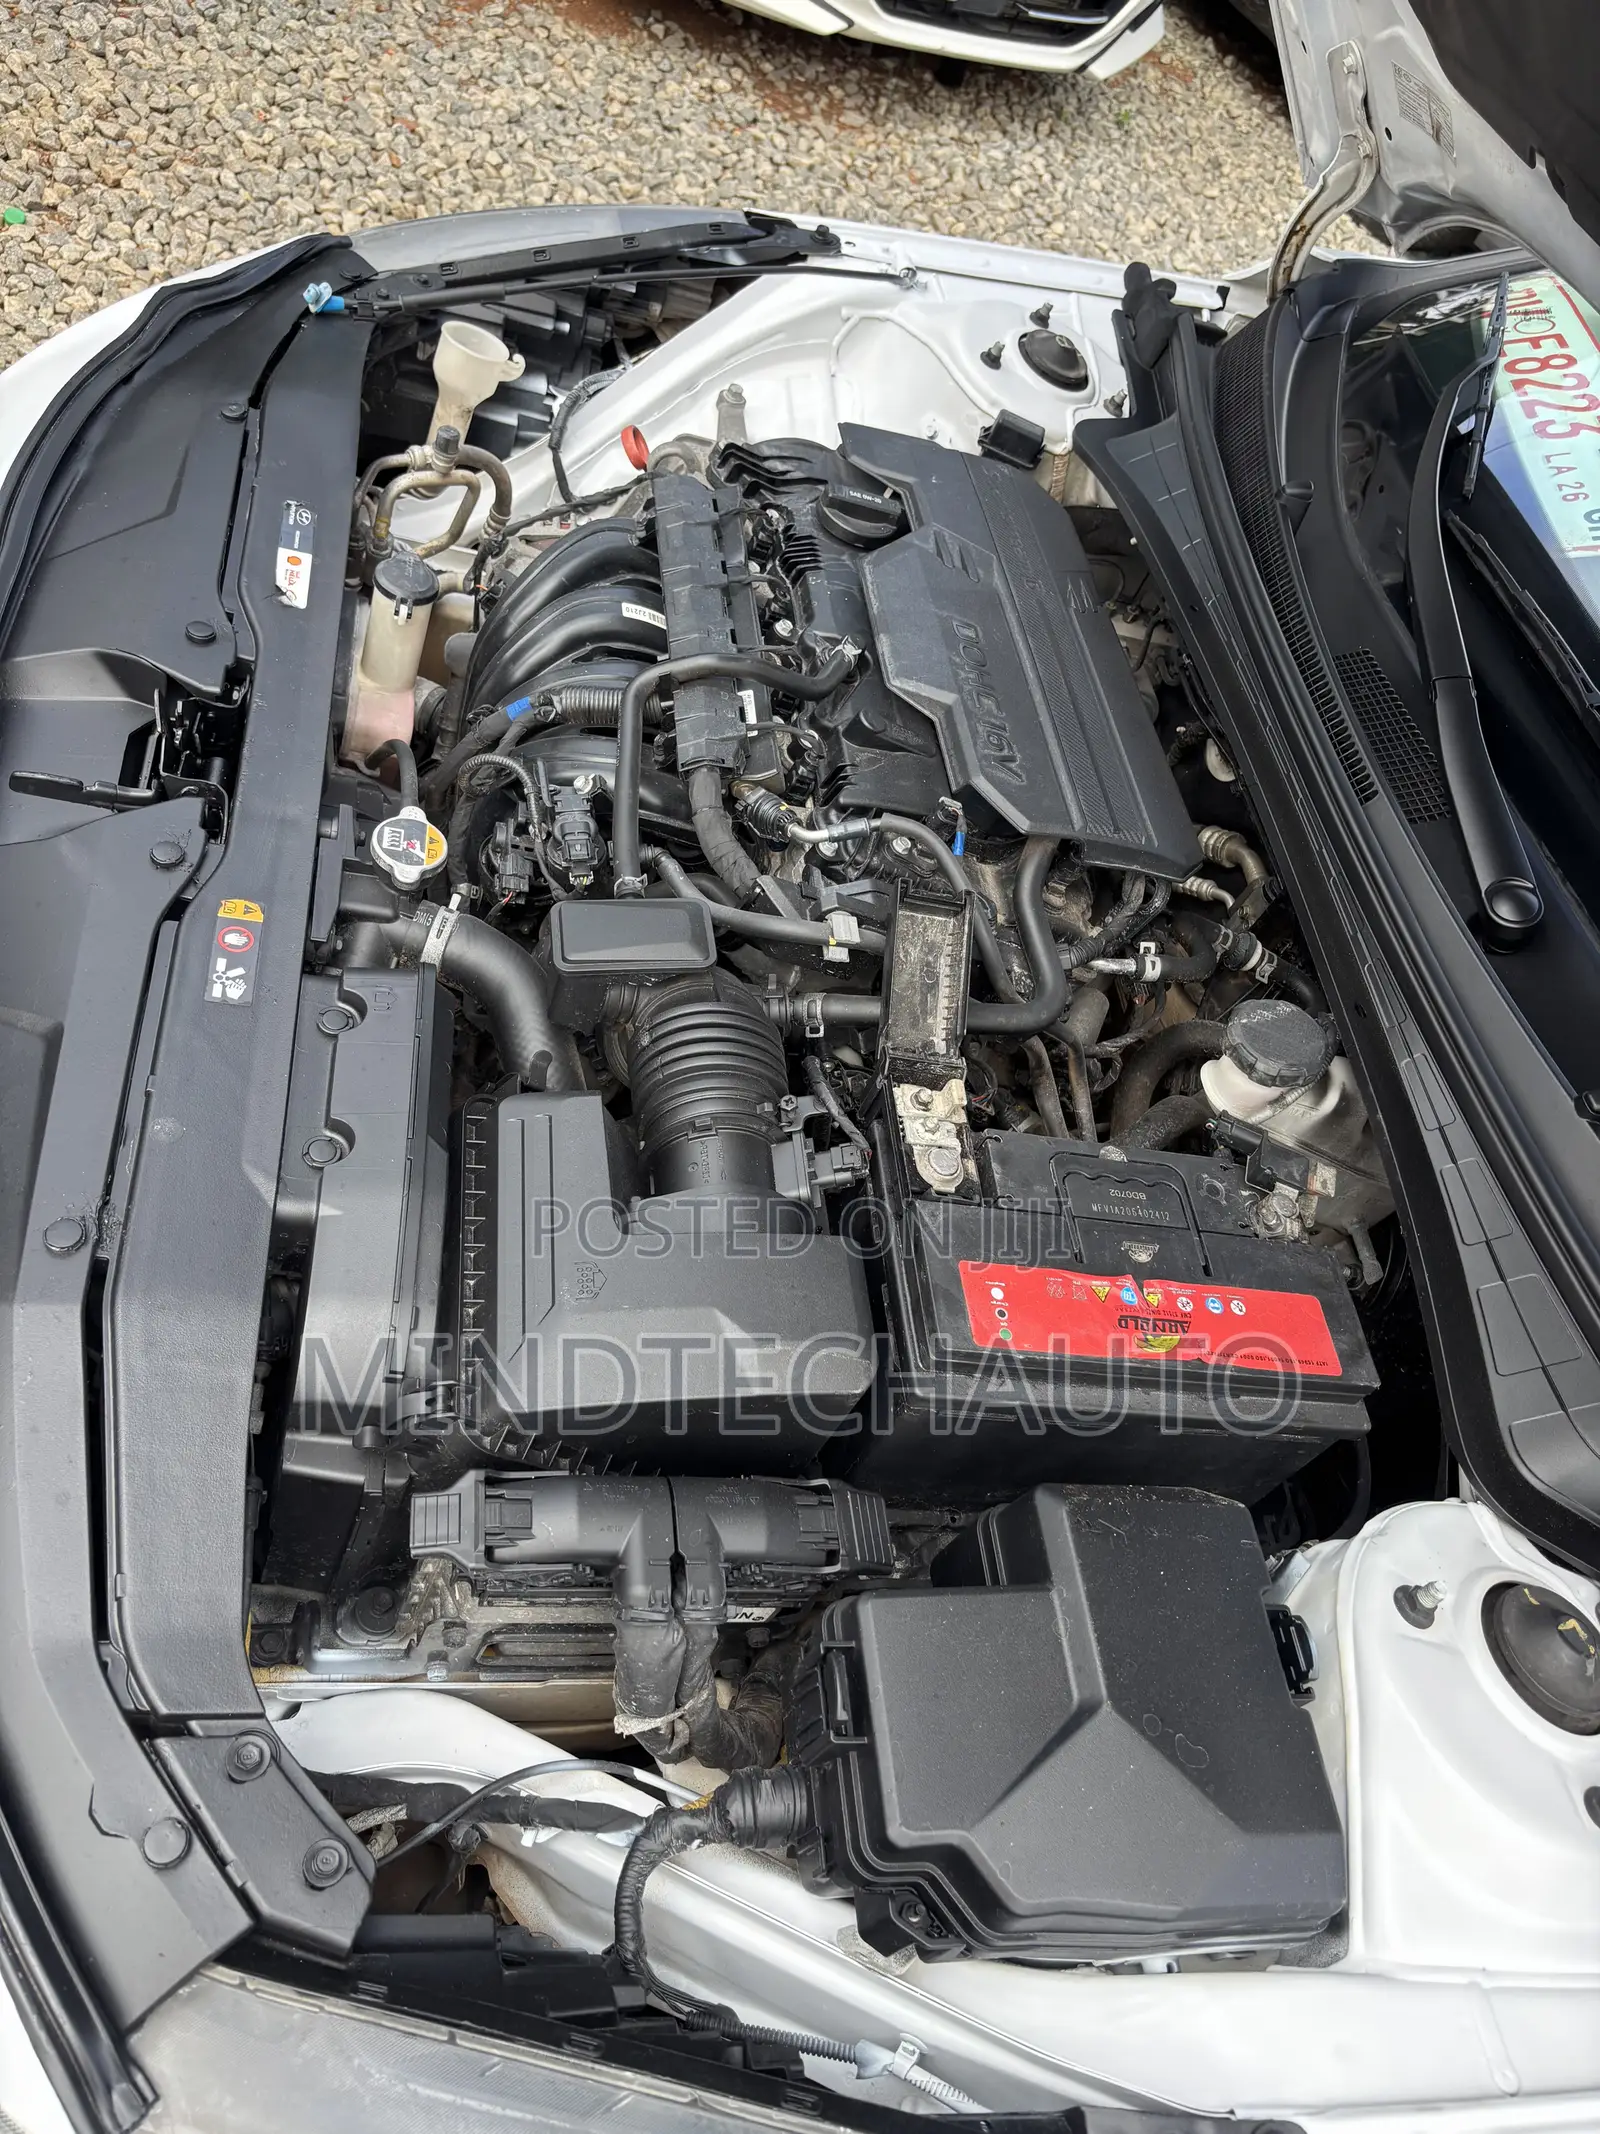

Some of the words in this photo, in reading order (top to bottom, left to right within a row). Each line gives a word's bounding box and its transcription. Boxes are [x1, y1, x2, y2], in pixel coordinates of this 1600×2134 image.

[1498, 333, 1600, 440] E8223
[1543, 452, 1578, 477] LA
[849, 490, 862, 499] SAE
[862, 494, 882, 504] 0W-20
[1556, 481, 1590, 503] 26
[952, 620, 1006, 716] DOHC
[980, 719, 1027, 785] 16V
[1109, 1188, 1147, 1200] BD0702
[1117, 1315, 1192, 1337] ARNOLD
